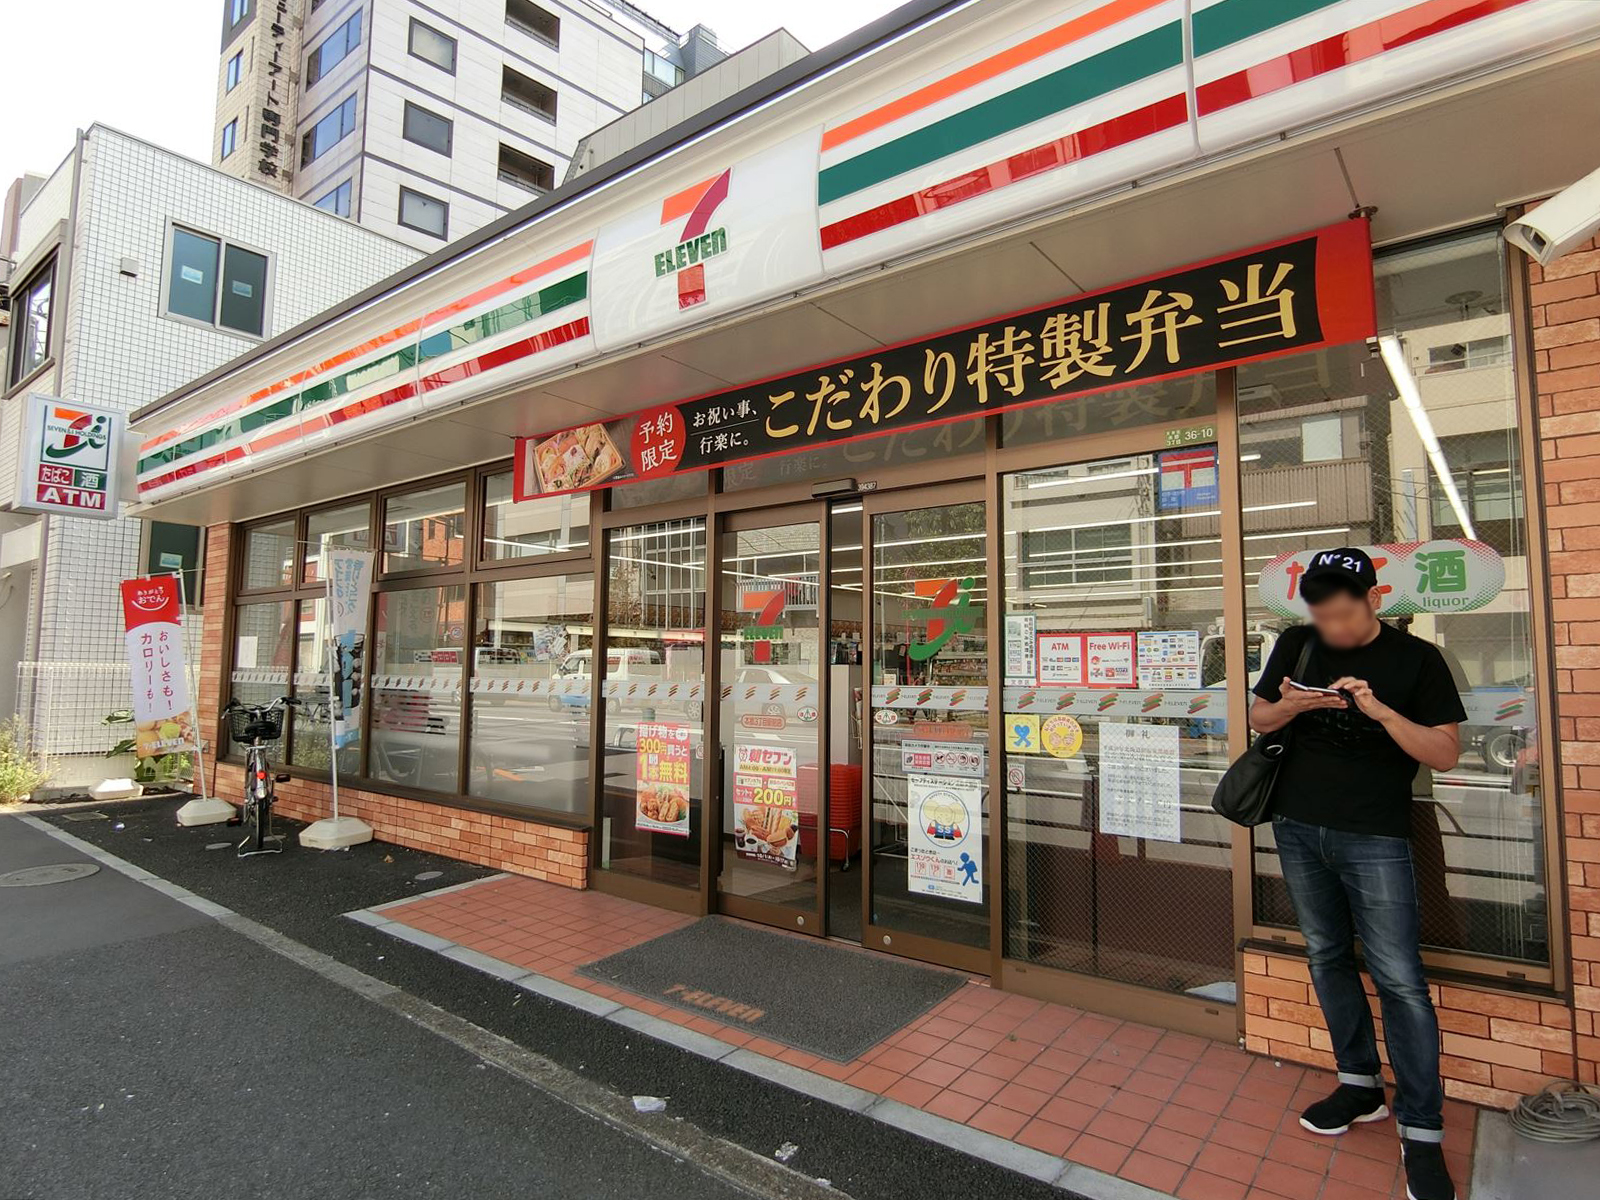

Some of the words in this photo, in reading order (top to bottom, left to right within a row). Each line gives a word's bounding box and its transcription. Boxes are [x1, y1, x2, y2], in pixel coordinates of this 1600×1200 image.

[765, 263, 1296, 438] こだわり特製弁当
[693, 399, 758, 428] お祝い事、
[639, 411, 674, 444] 予約
[1184, 428, 1213, 440] 36-10
[699, 432, 749, 455] 行楽に。
[641, 440, 677, 472] 限定
[41, 466, 70, 484] たばこ
[81, 472, 100, 488] 酒
[41, 486, 102, 508] ATM
[1342, 557, 1361, 573] 21
[1415, 550, 1467, 593] 酒
[1423, 596, 1470, 608] liquor
[1051, 643, 1069, 651] ATM
[1089, 642, 1107, 651] Free
[1109, 642, 1130, 651] Wi-Fi
[749, 749, 792, 766] 朝セブン
